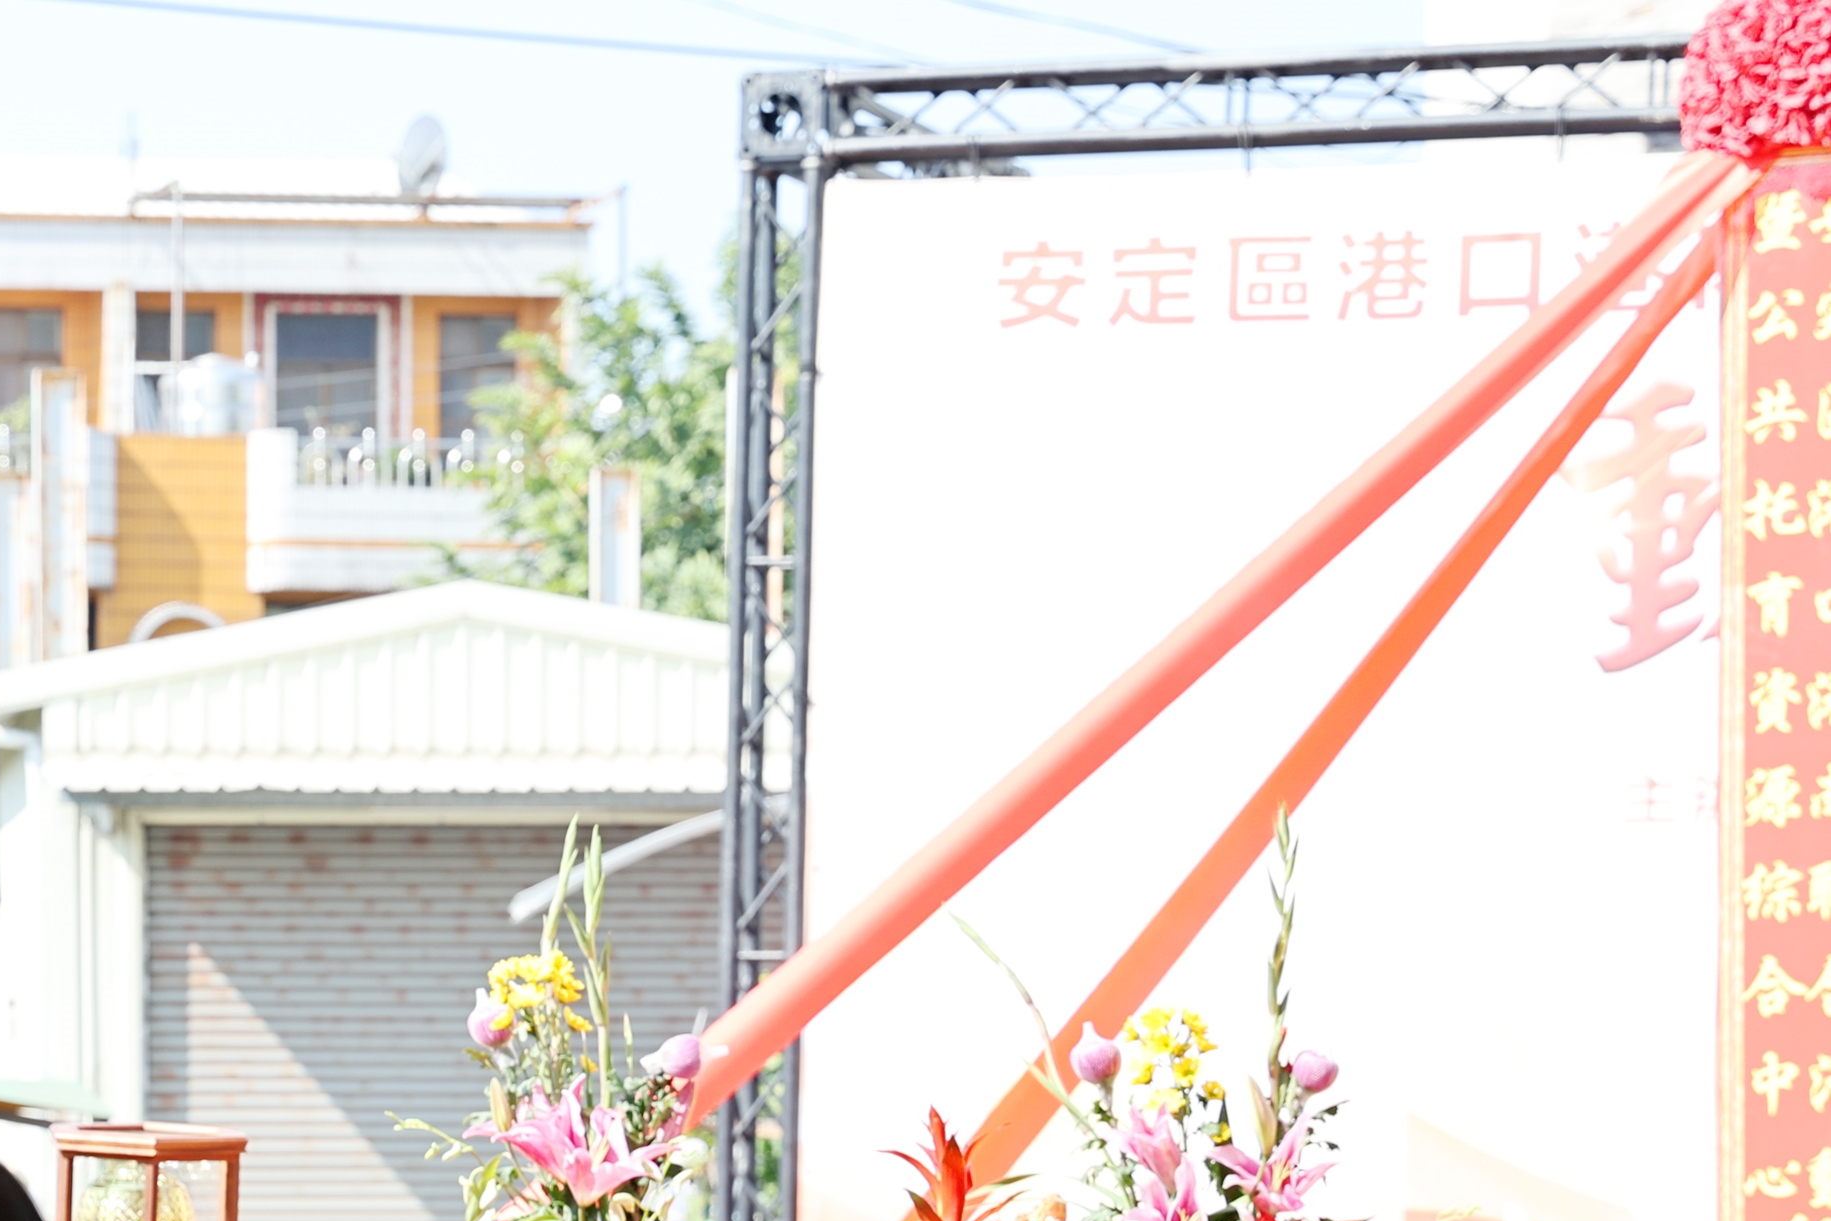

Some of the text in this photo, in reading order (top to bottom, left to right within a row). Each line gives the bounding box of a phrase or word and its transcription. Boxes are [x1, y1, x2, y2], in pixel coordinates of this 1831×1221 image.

[997, 222, 1718, 329] 安定區港口
